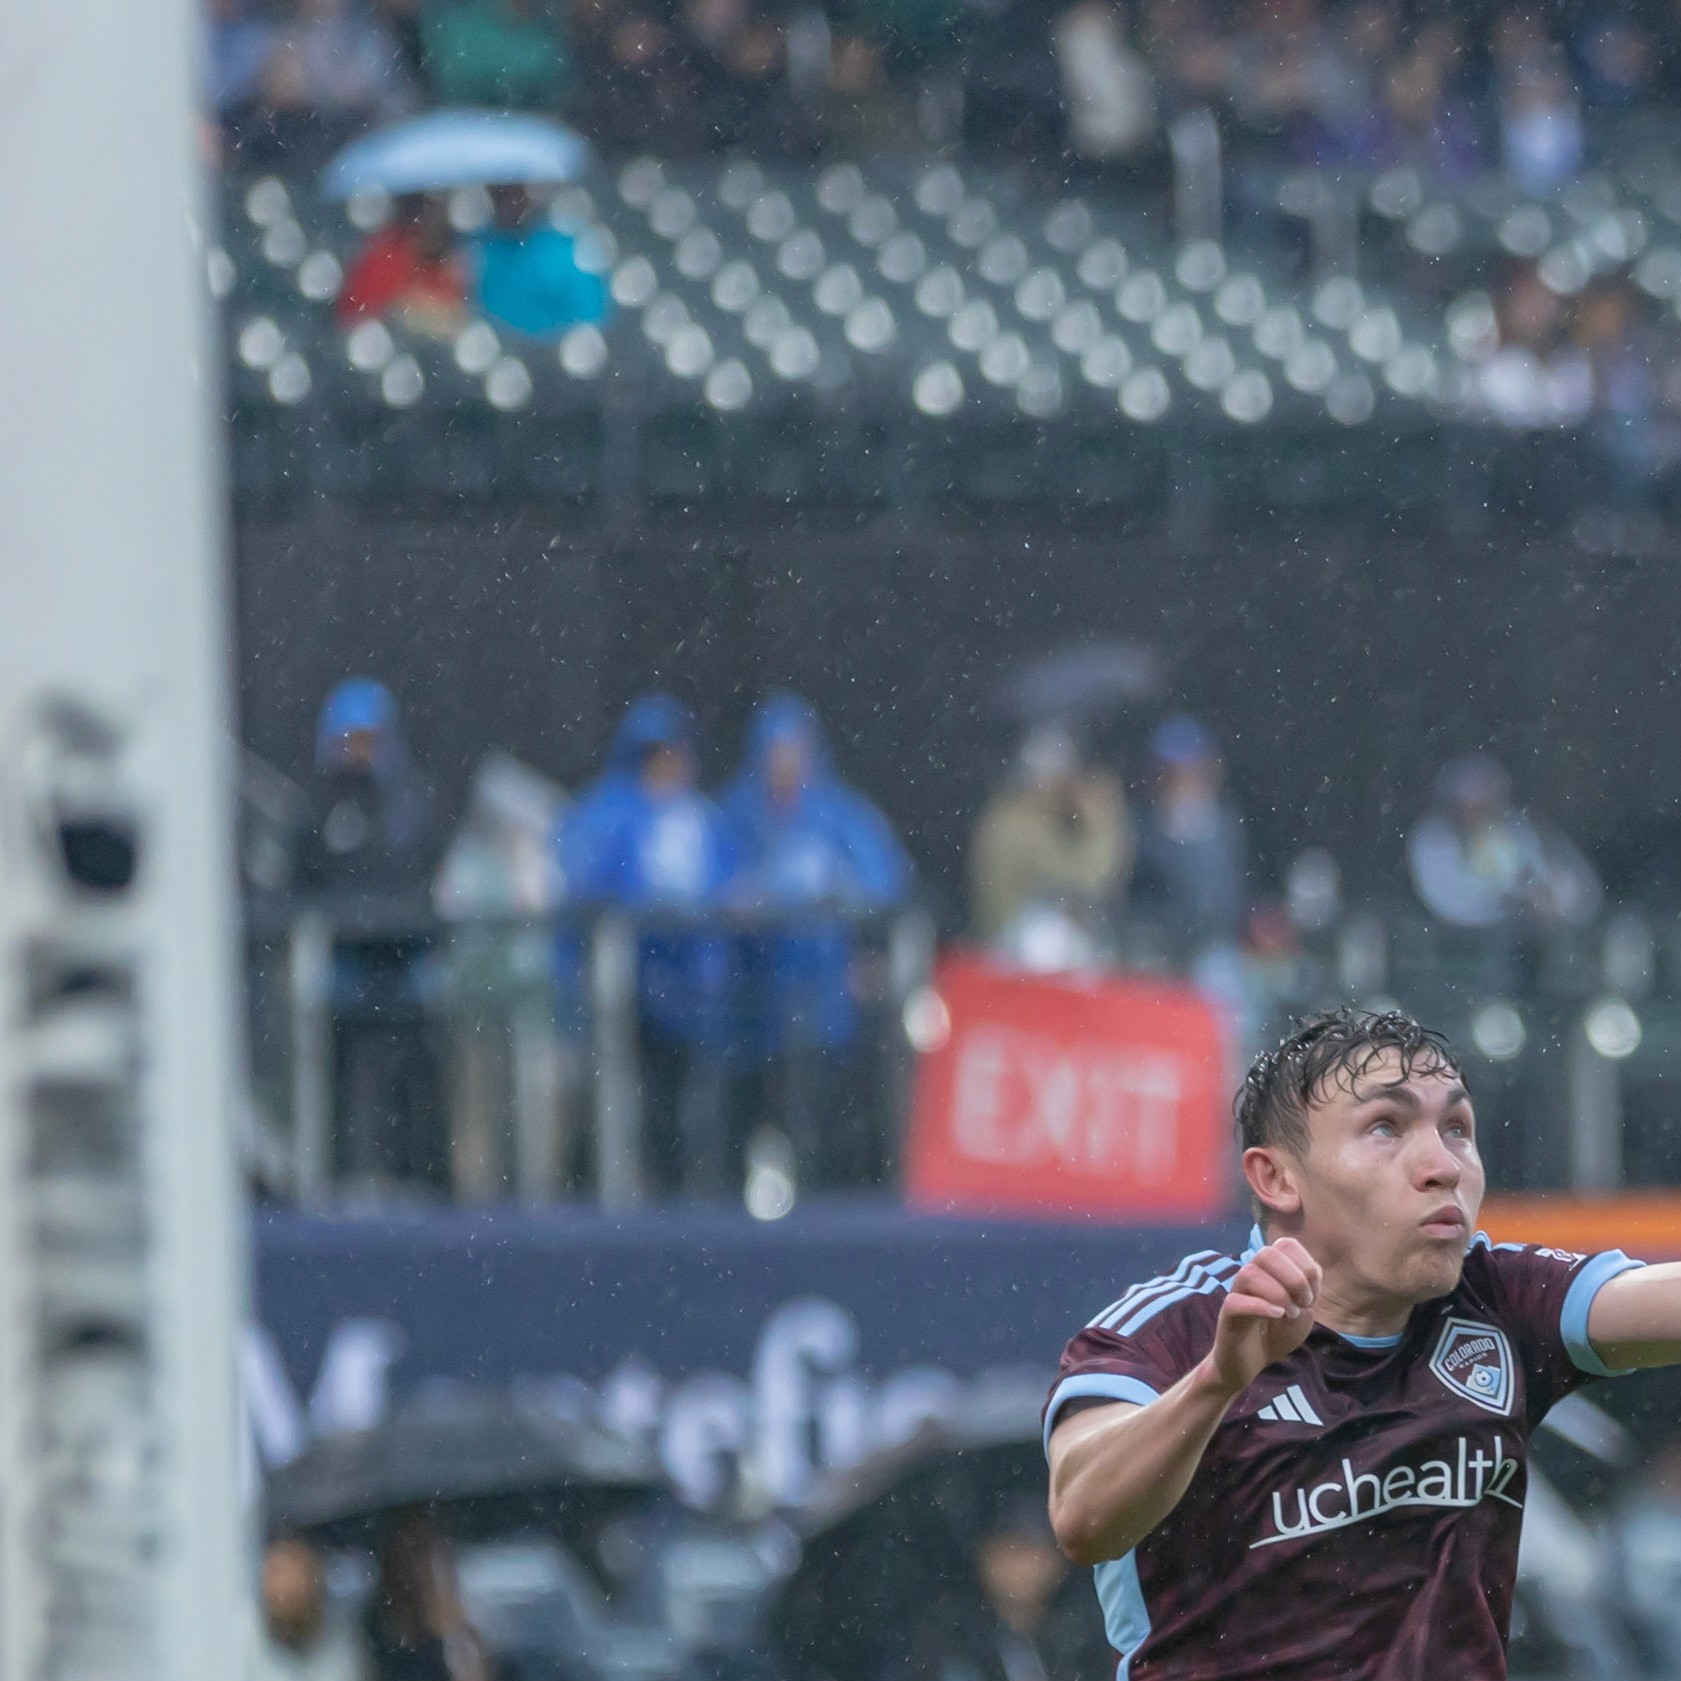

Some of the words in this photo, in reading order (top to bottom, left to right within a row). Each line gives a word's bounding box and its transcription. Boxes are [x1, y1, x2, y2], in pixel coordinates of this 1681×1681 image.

[953, 1027, 1182, 1187] EXIT
[1444, 1337, 1496, 1372] COLORADO
[1258, 1435, 1524, 1544] uchealth
